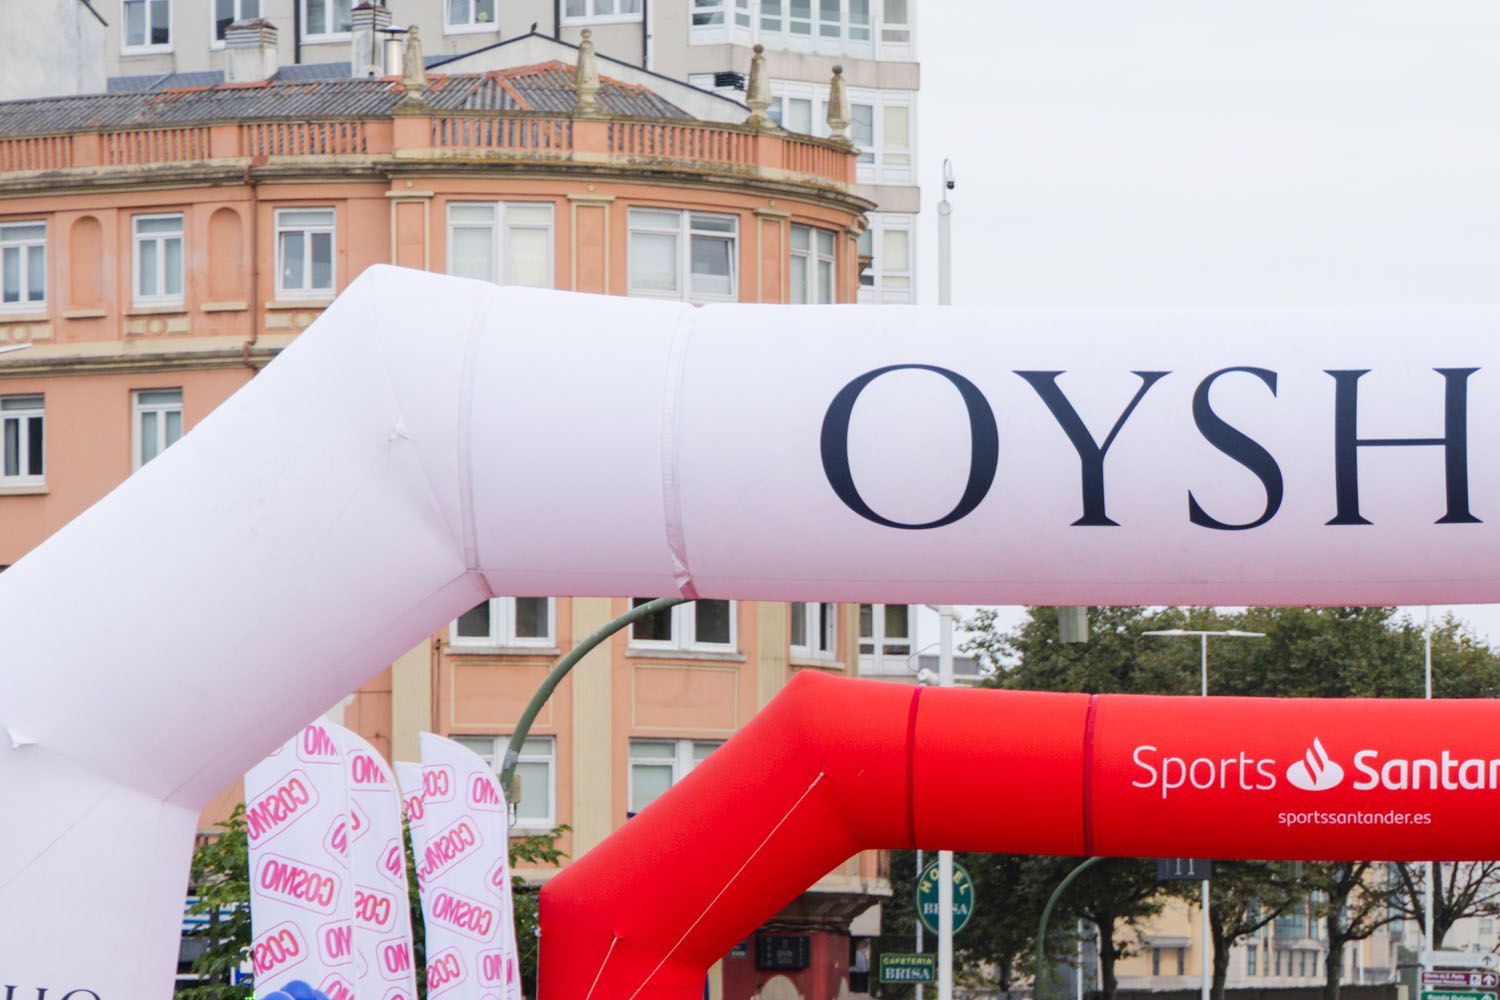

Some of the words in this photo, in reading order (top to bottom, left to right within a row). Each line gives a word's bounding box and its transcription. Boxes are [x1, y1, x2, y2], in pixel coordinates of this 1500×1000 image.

[1131, 745, 1276, 799] Sports
[1278, 810, 1432, 827] sportssantander.es
[920, 868, 971, 895] HOEL
[883, 957, 932, 965] CAFETERIA
[885, 967, 930, 980] BRISA
